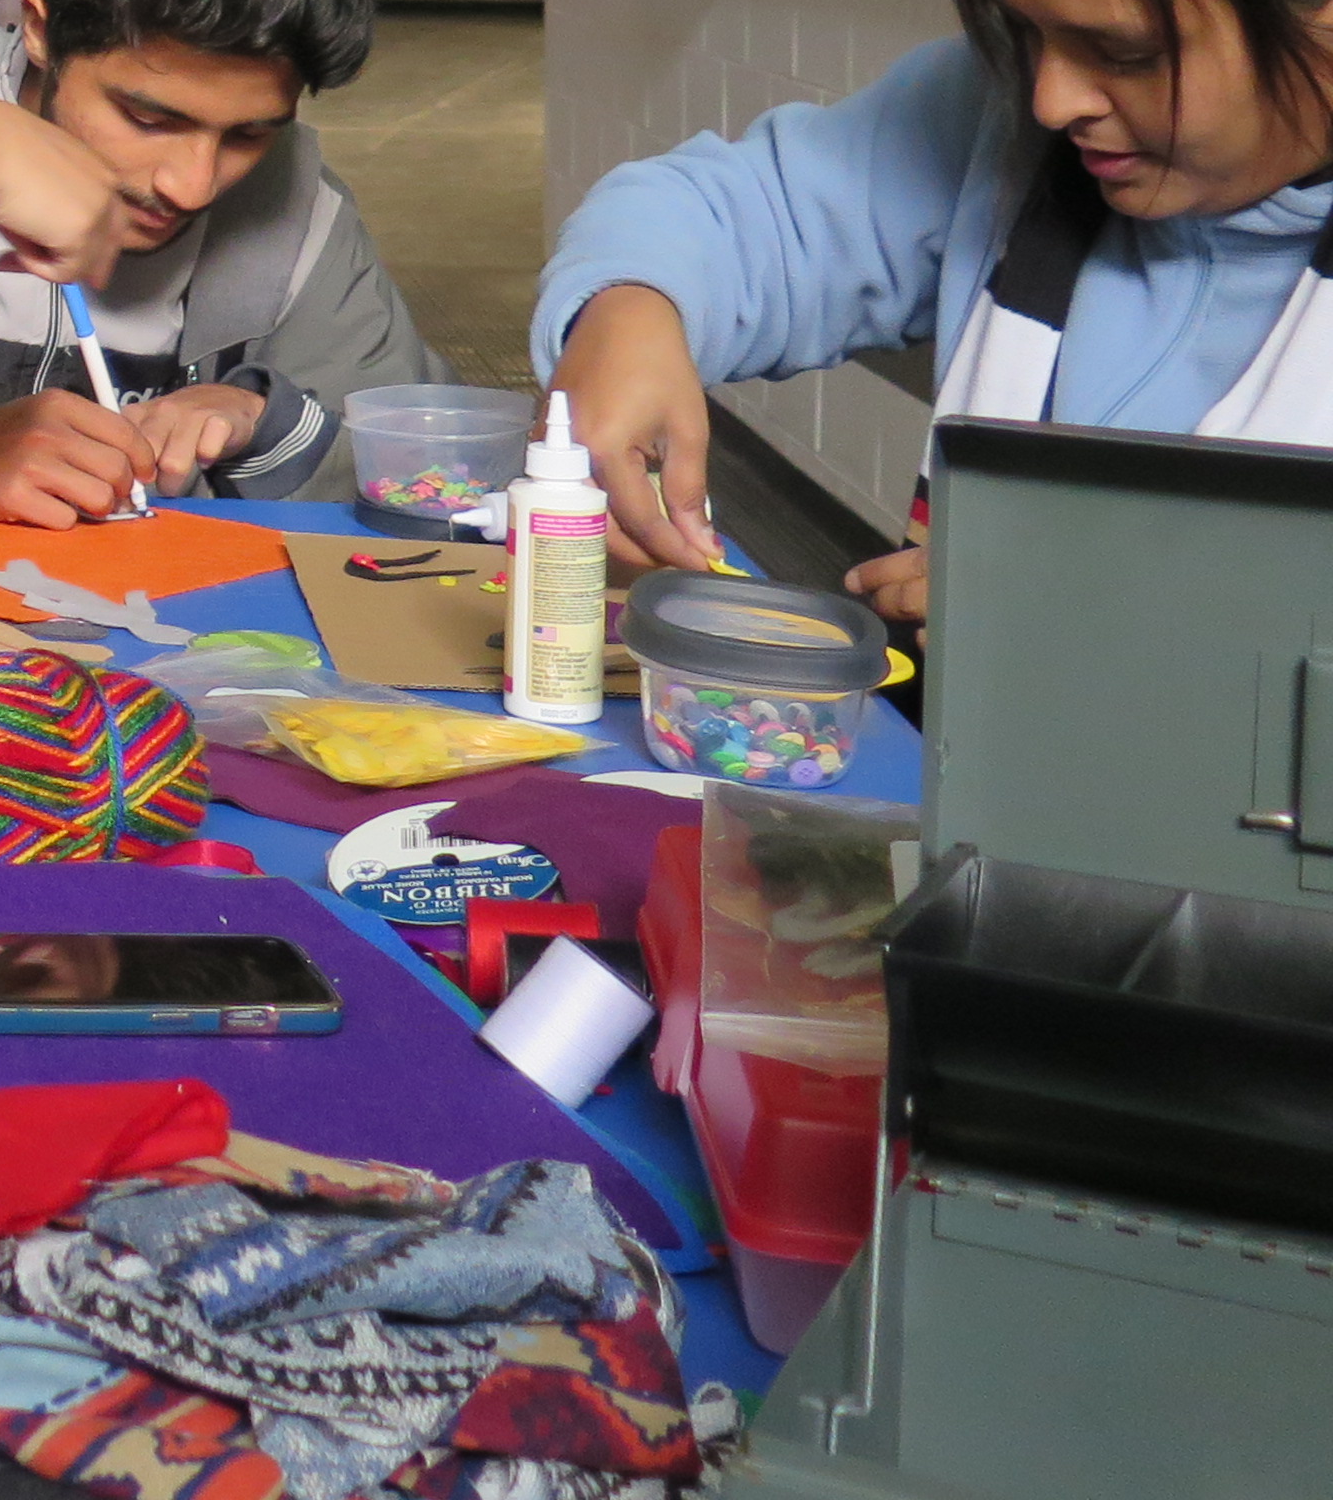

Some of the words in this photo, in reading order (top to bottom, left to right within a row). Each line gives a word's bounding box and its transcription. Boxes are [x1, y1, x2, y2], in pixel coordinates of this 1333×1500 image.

[454, 876, 502, 886] YARDAGE
[503, 873, 534, 884] MORE
[361, 882, 393, 891] VALUE
[393, 880, 424, 890] MORE
[382, 882, 512, 904] RIBBON
